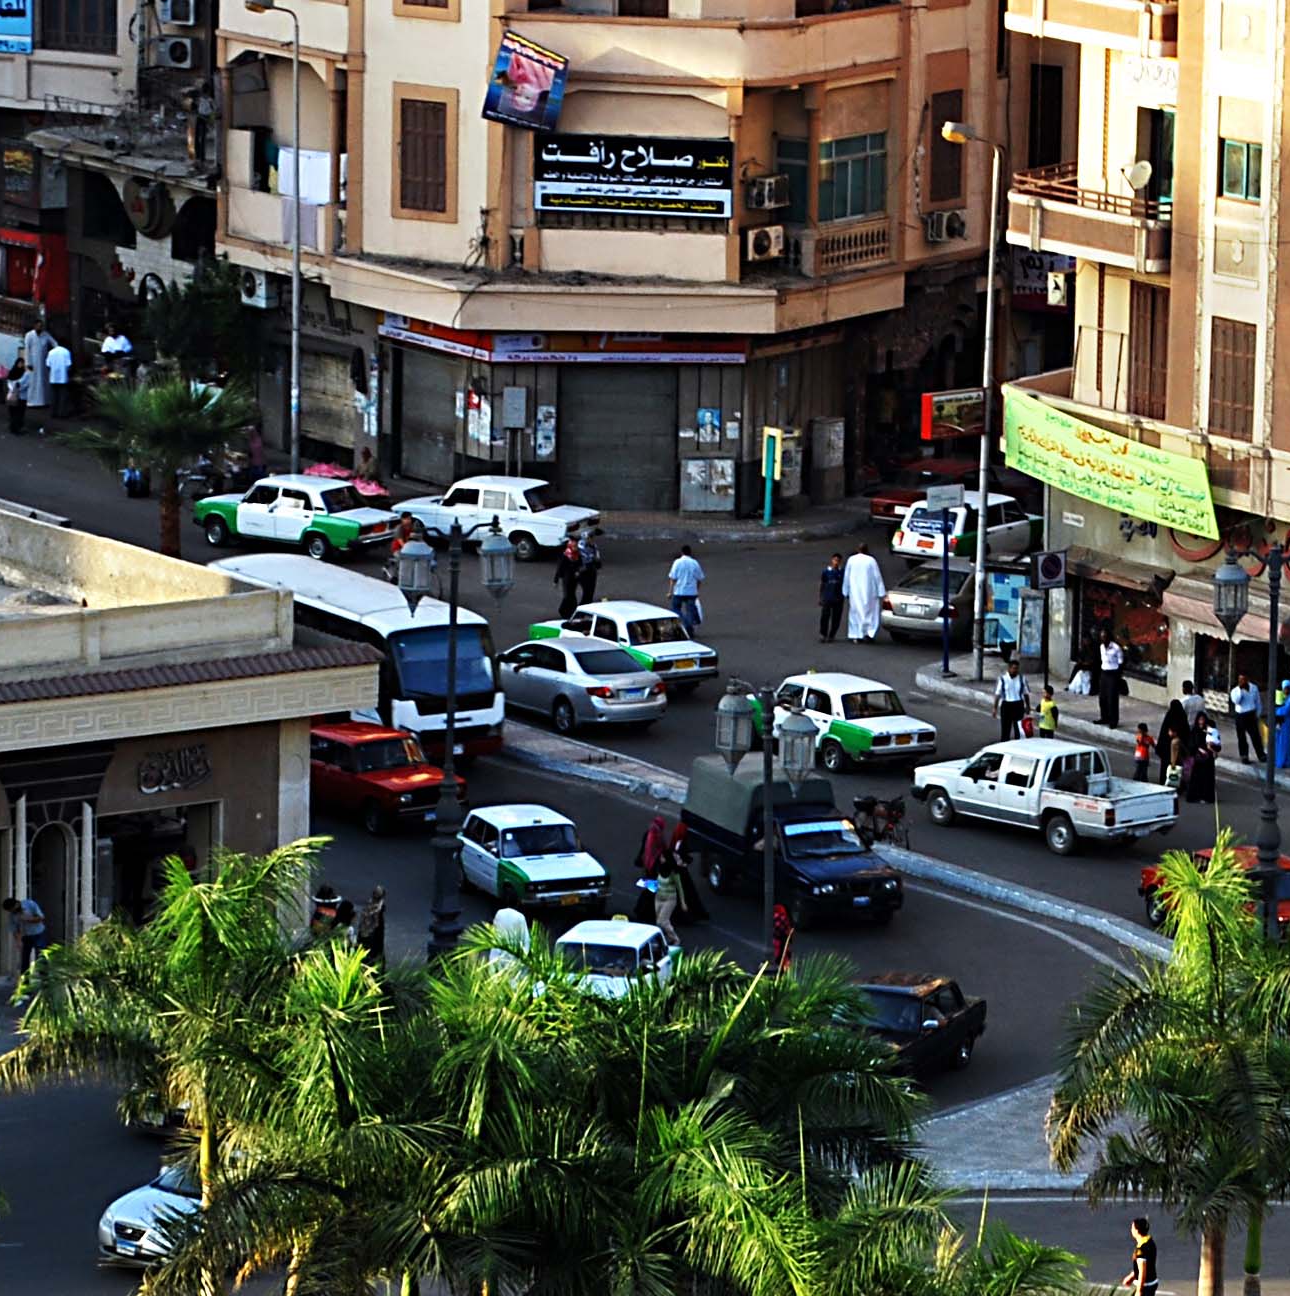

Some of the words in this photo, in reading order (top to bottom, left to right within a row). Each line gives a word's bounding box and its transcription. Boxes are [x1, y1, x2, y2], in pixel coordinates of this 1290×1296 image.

[541, 140, 616, 169] رأفت
[620, 145, 694, 172] صلاح
[697, 154, 729, 169] دكتور
